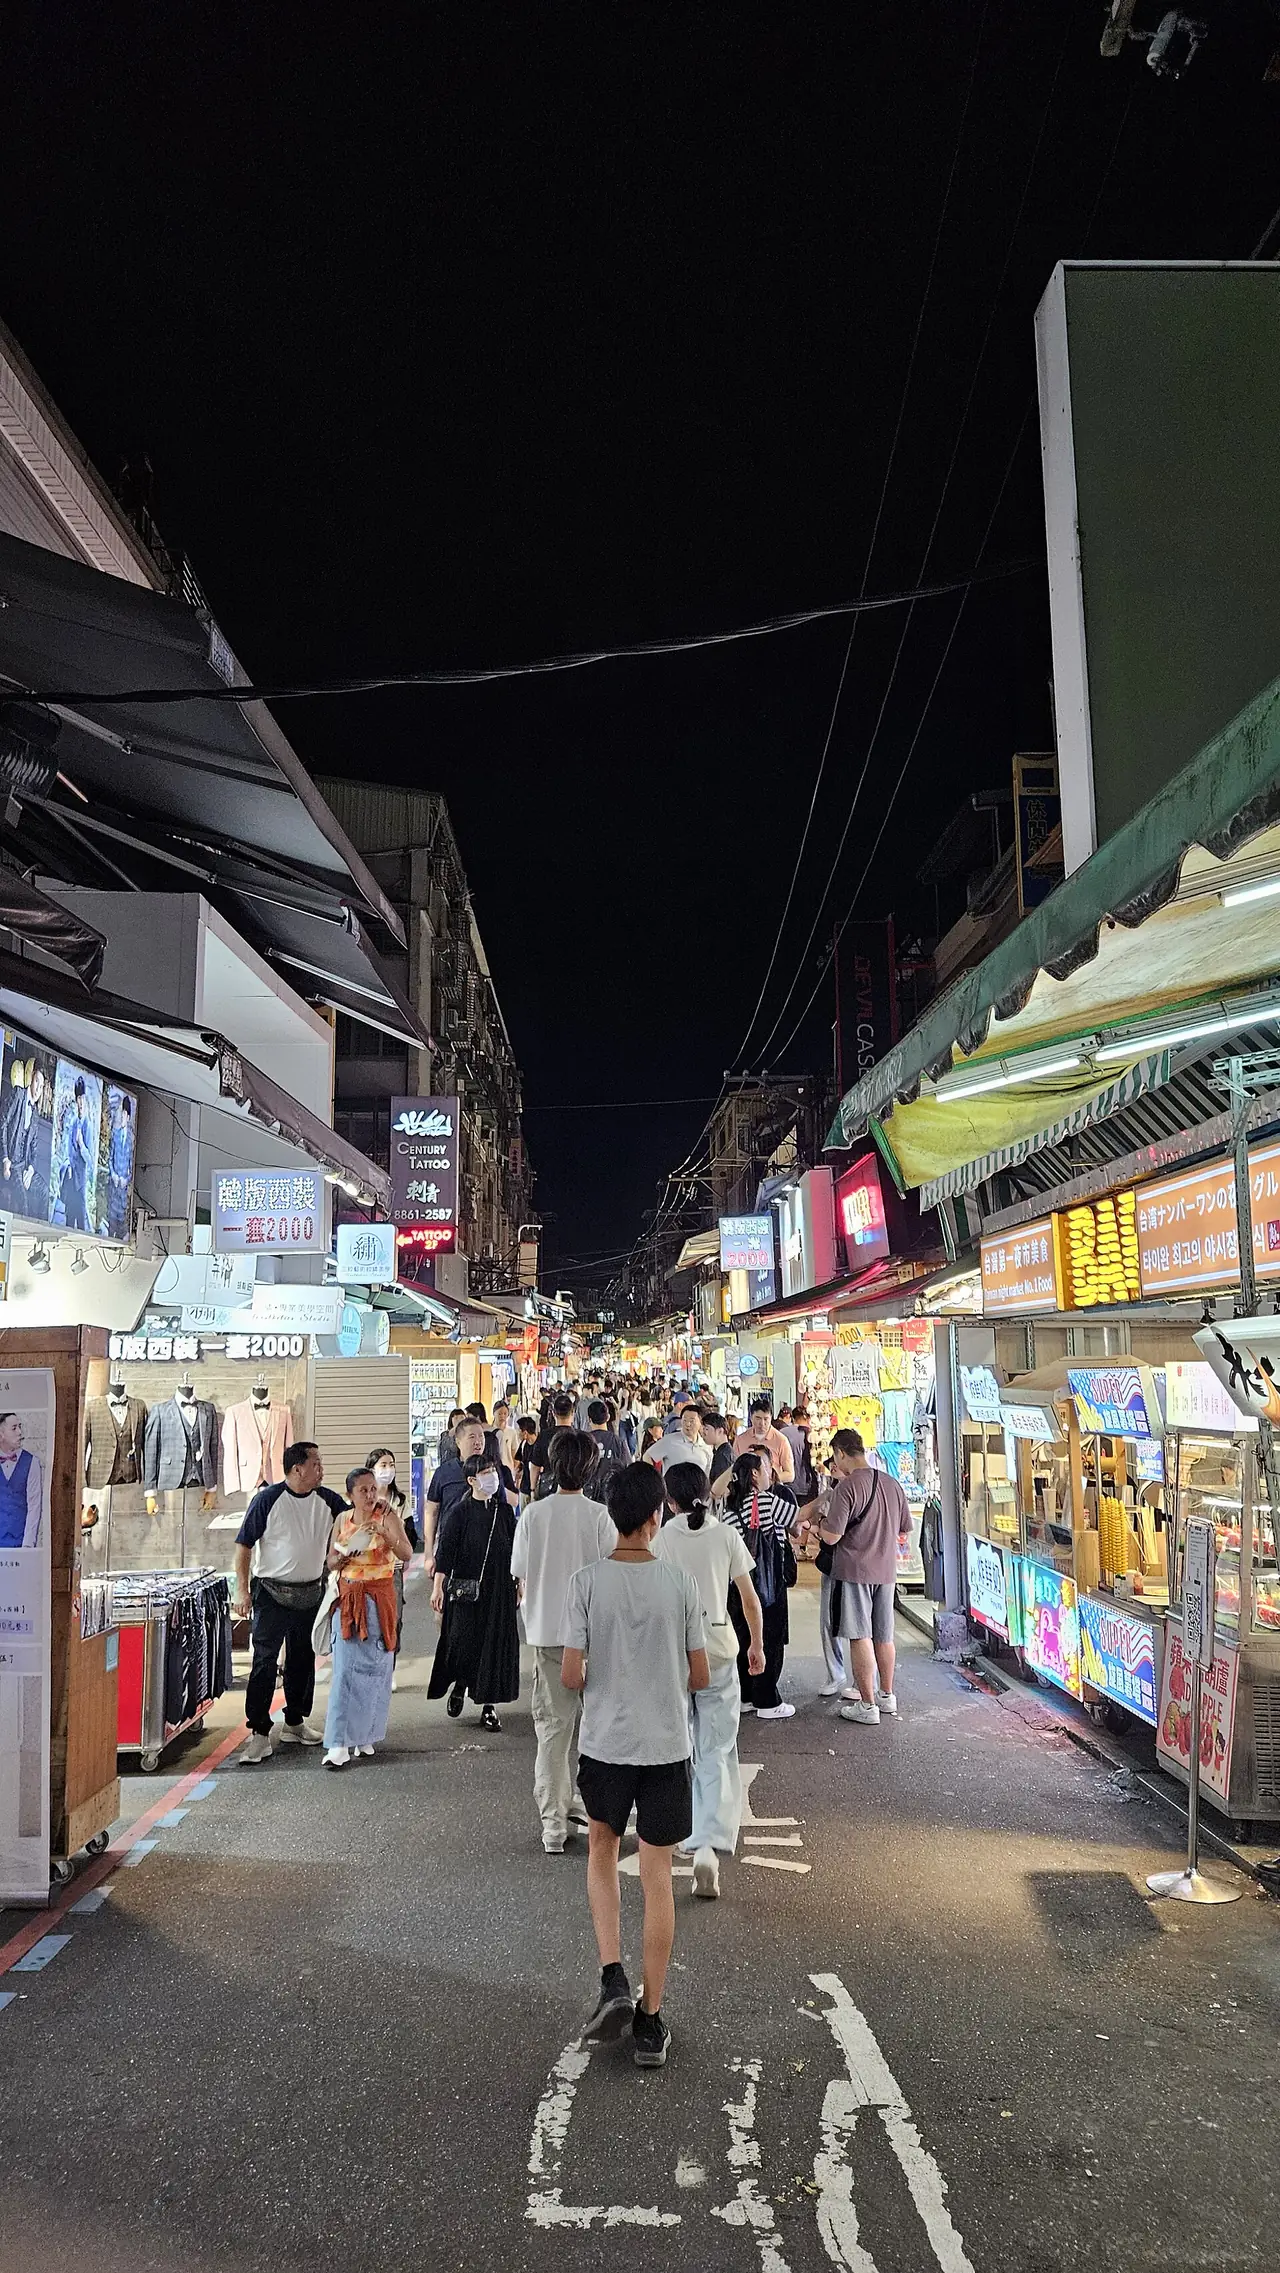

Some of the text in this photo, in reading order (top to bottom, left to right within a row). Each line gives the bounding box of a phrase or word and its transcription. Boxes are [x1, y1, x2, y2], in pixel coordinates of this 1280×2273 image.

[397, 1142, 447, 1155] CENTURY
[409, 1156, 450, 1170] TATTOO
[218, 1177, 316, 1212] 韓版西裝
[406, 1180, 440, 1204] 刺青
[223, 1216, 314, 1244] 一套2000
[411, 1229, 452, 1242] TATTOO
[727, 1250, 768, 1266] 2000
[1172, 1238, 1201, 1269] 최고의
[1038, 1273, 1053, 1293] Food
[1090, 1377, 1124, 1404] SUPER
[1100, 1617, 1132, 1665] SUPER
